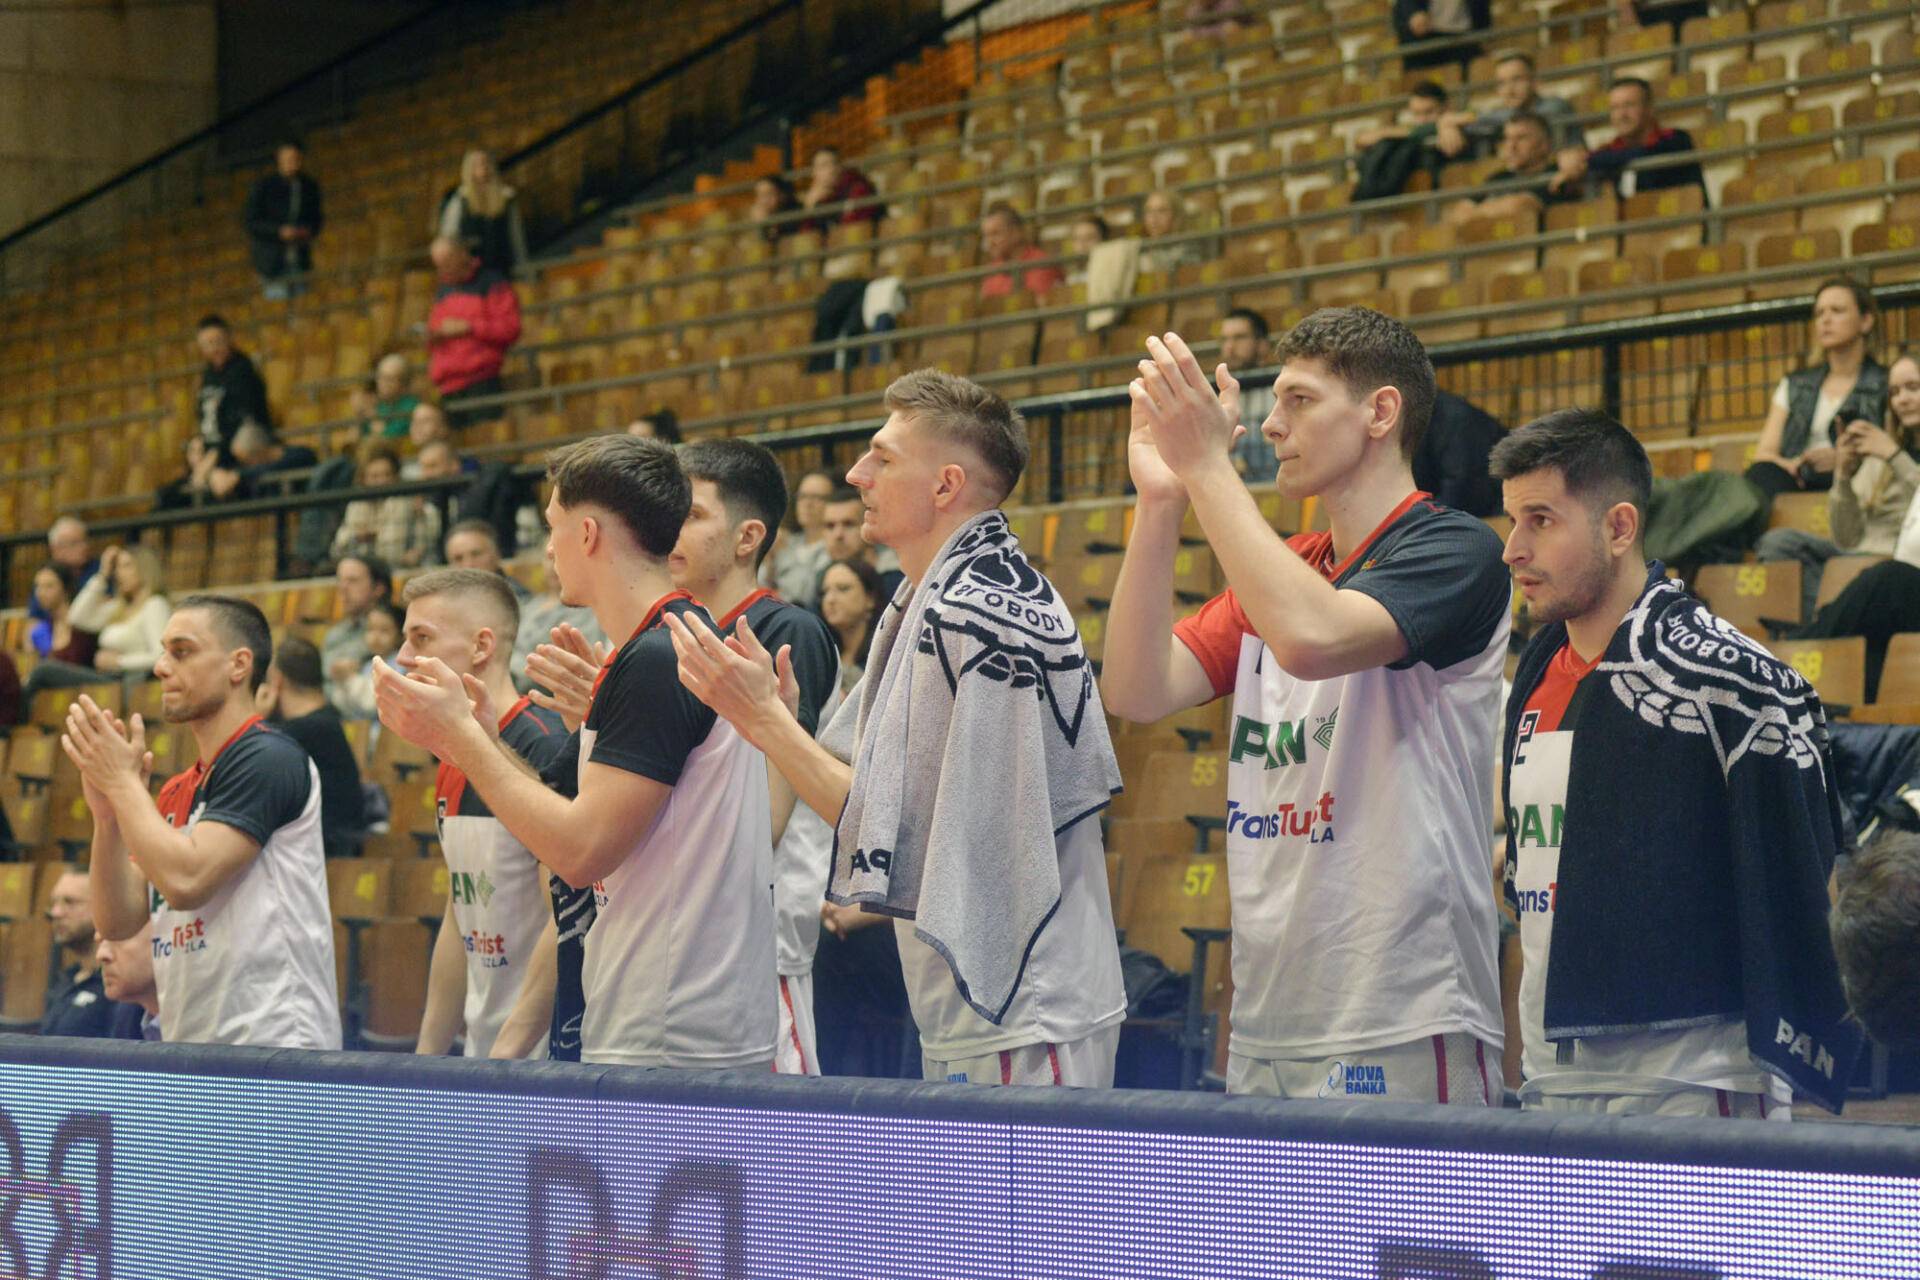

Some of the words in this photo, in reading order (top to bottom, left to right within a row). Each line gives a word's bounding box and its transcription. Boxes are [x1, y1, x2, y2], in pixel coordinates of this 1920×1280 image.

[1229, 714, 1307, 770] PAN
[1184, 864, 1216, 896] 57
[1774, 1017, 1834, 1080] PAN
[1345, 1065, 1384, 1081] NOVA
[1345, 1081, 1387, 1095] BANKA
